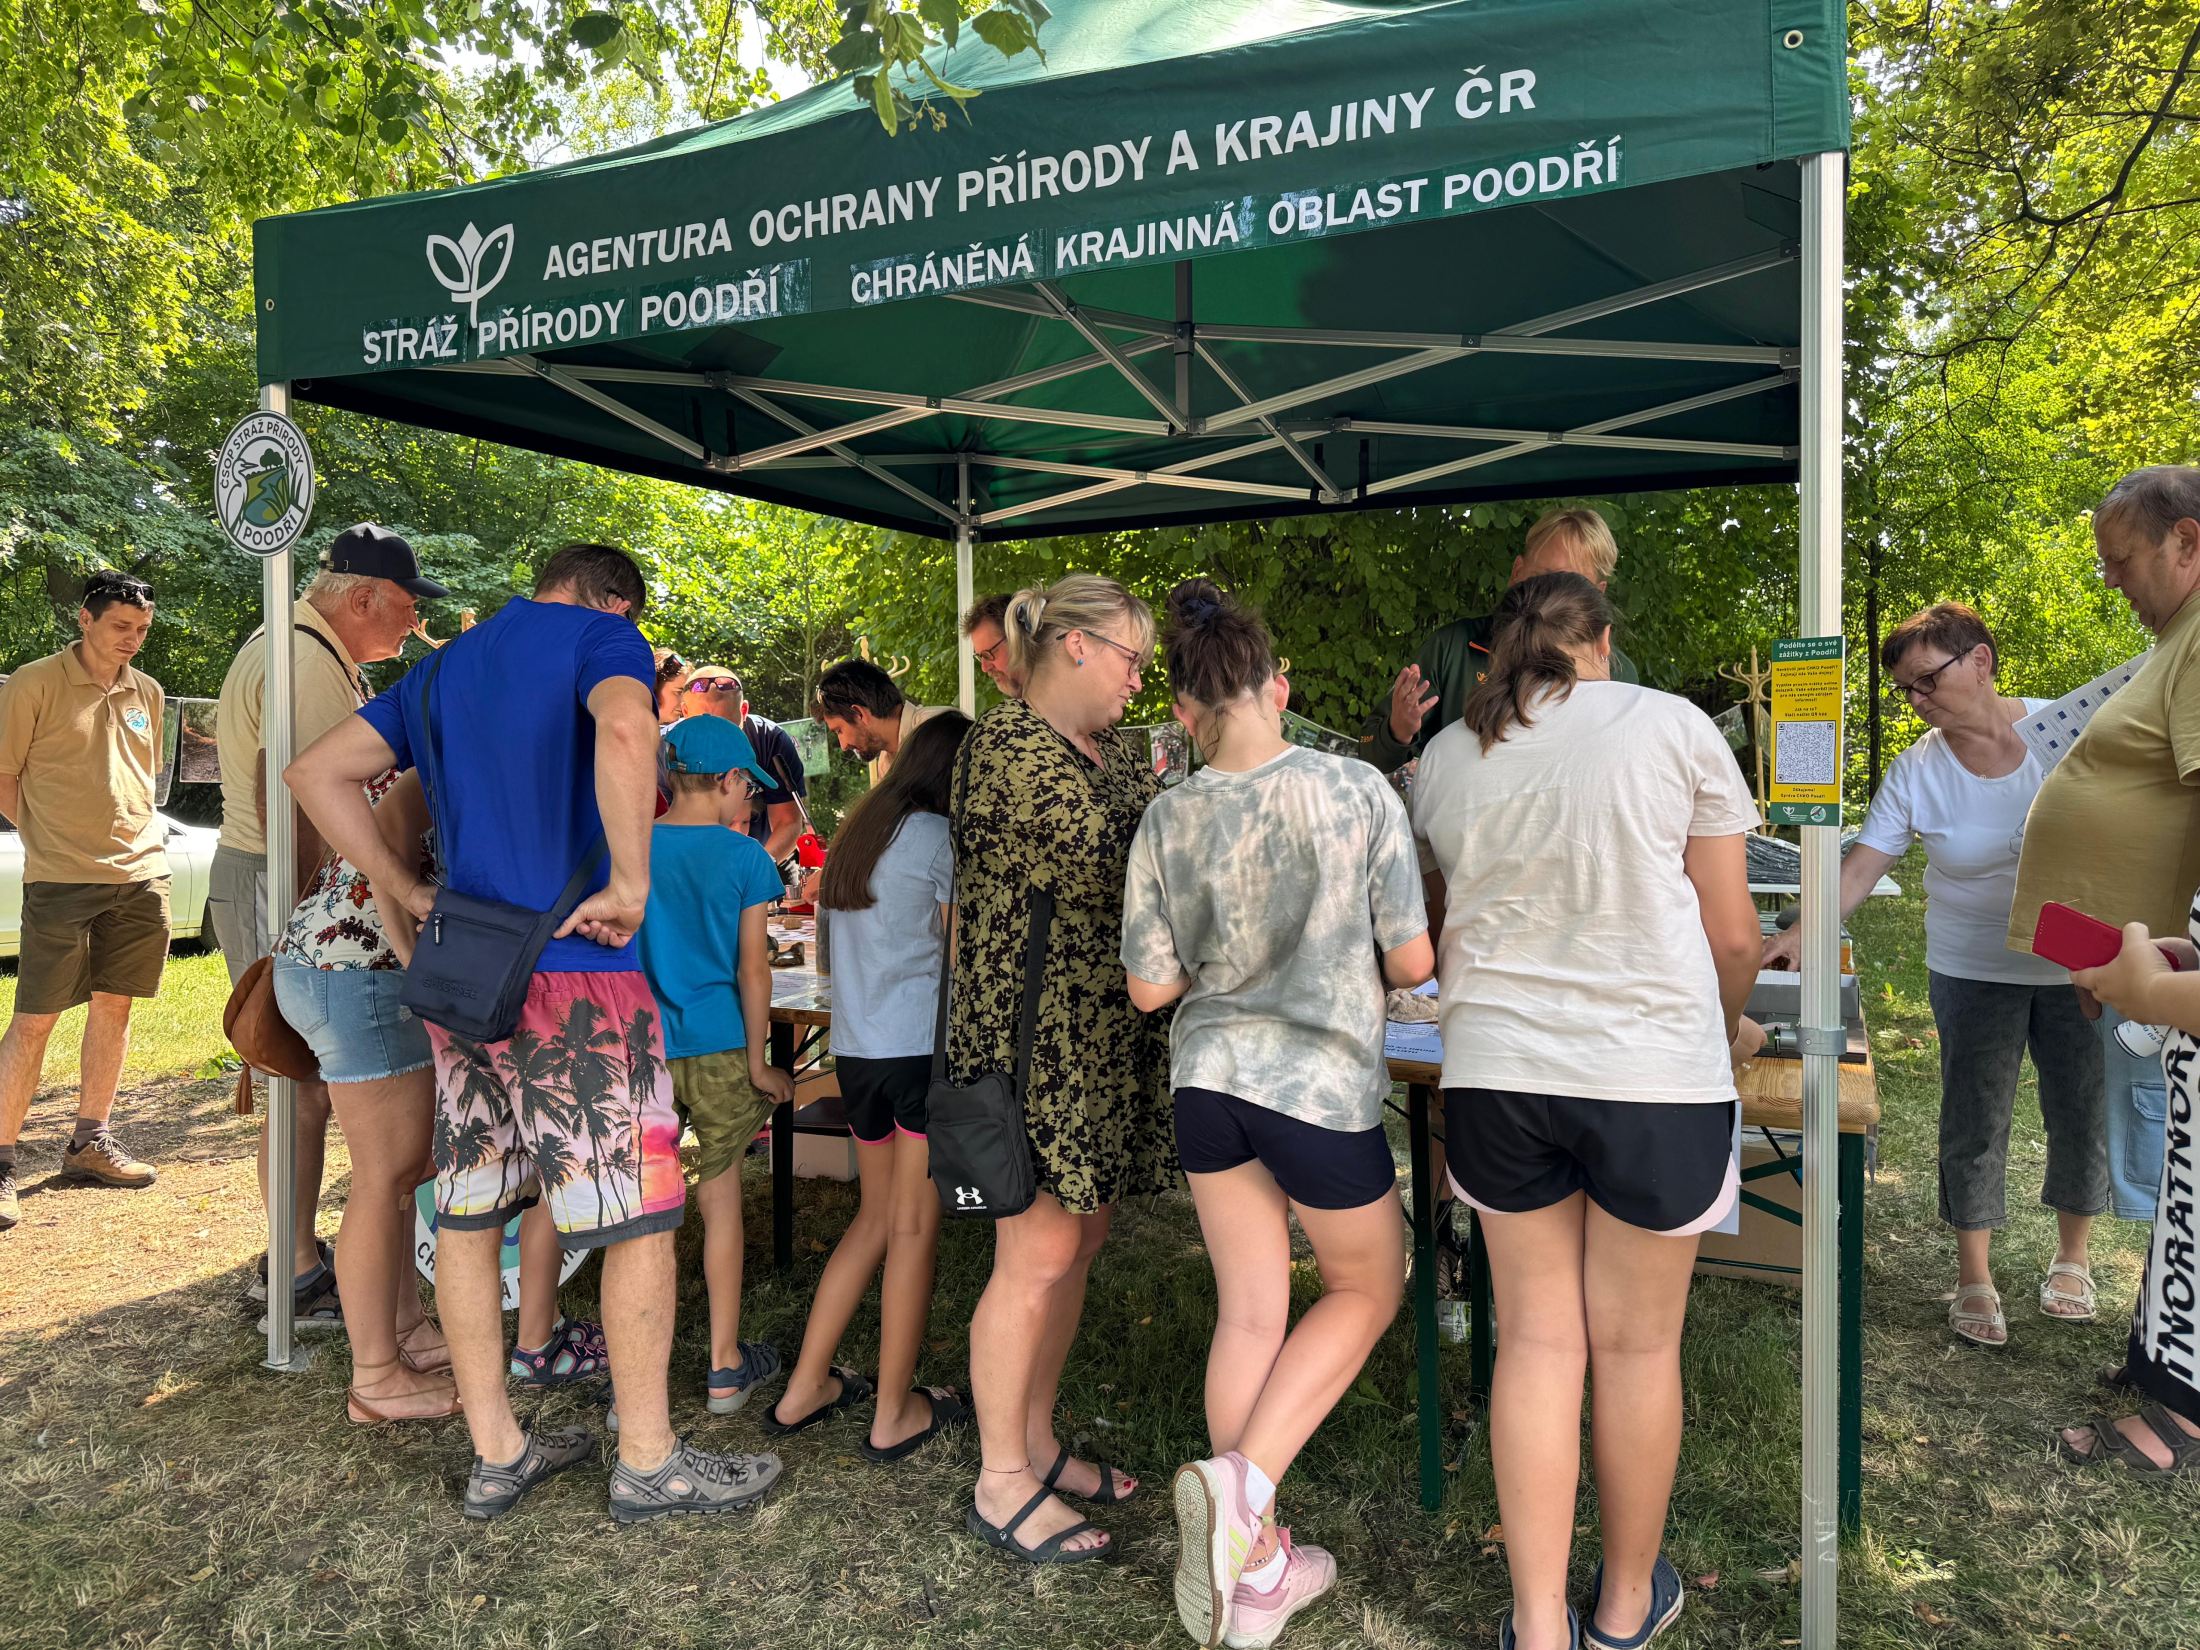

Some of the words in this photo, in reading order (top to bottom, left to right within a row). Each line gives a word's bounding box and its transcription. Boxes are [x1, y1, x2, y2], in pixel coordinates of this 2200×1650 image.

[543, 217, 732, 280] AGENTURA
[749, 176, 941, 247] OCHRANY
[958, 136, 1152, 211] PŘÍRODY
[1167, 130, 1199, 175] A
[1215, 88, 1434, 165] KRAJINY
[1456, 64, 1536, 121] ČR
[851, 231, 1034, 304] CHRÁNĚNÁ
[1056, 202, 1238, 270] KRAJINNÁ
[1268, 178, 1431, 235] OBLAST
[1444, 135, 1621, 209] POODŘÍ
[363, 314, 457, 364] STRÁŽ
[477, 298, 625, 355] PŘÍRODY
[641, 263, 780, 331] POODŘÍ
[220, 449, 234, 489] ČSOP
[233, 420, 264, 450] STRÁŽ
[266, 421, 304, 464] PŘÍRODY
[243, 510, 298, 546] POODŘÍ
[1778, 649, 1803, 658] zážitky
[1811, 648, 1838, 656] Poodří!
[1779, 641, 1806, 649] Podělte
